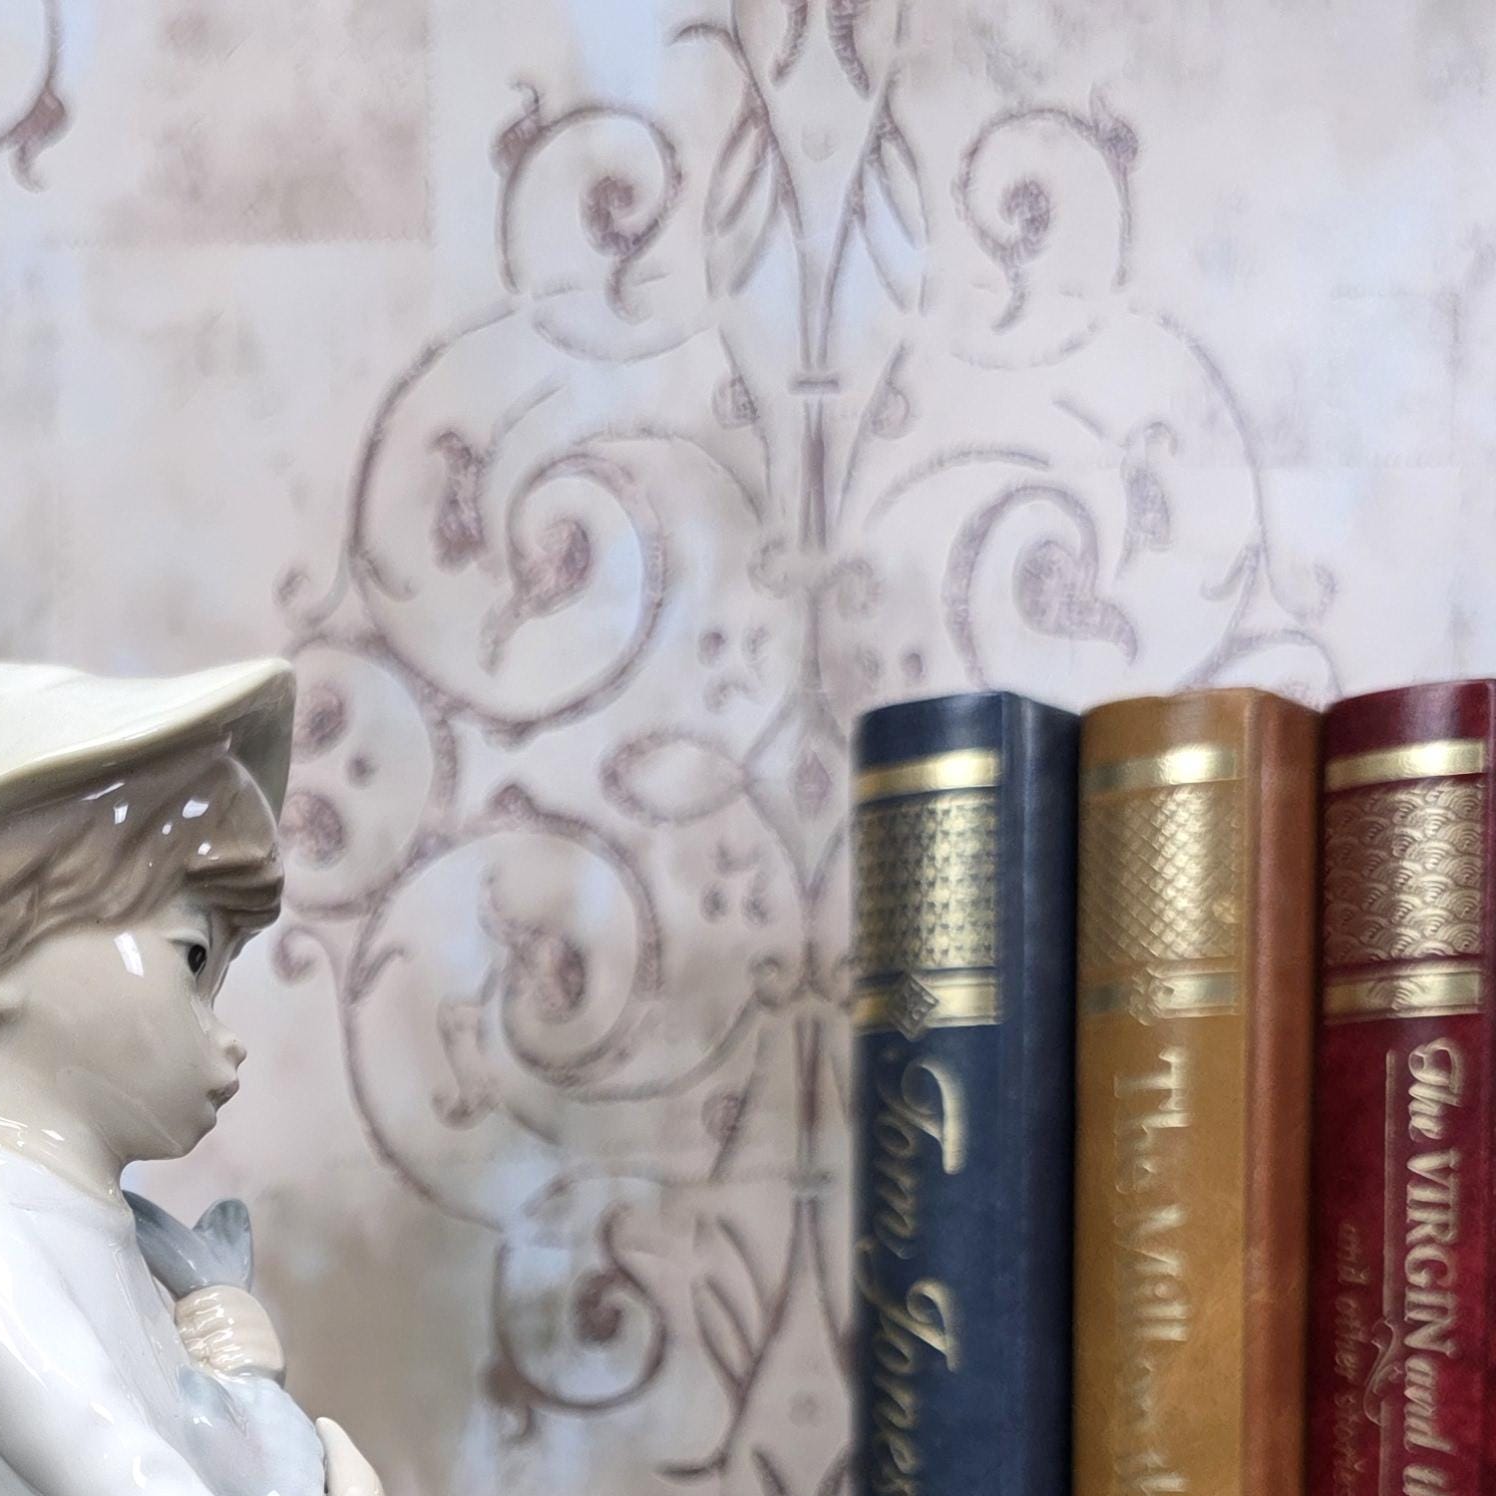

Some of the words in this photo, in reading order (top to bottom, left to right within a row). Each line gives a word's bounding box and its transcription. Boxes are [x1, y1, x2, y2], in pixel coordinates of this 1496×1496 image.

[872, 1054, 968, 1260] Tom
[1114, 1045, 1191, 1195] The
[1408, 1037, 1462, 1141] The
[1403, 1150, 1459, 1358] VIRGIN
[1403, 1358, 1454, 1453] and
